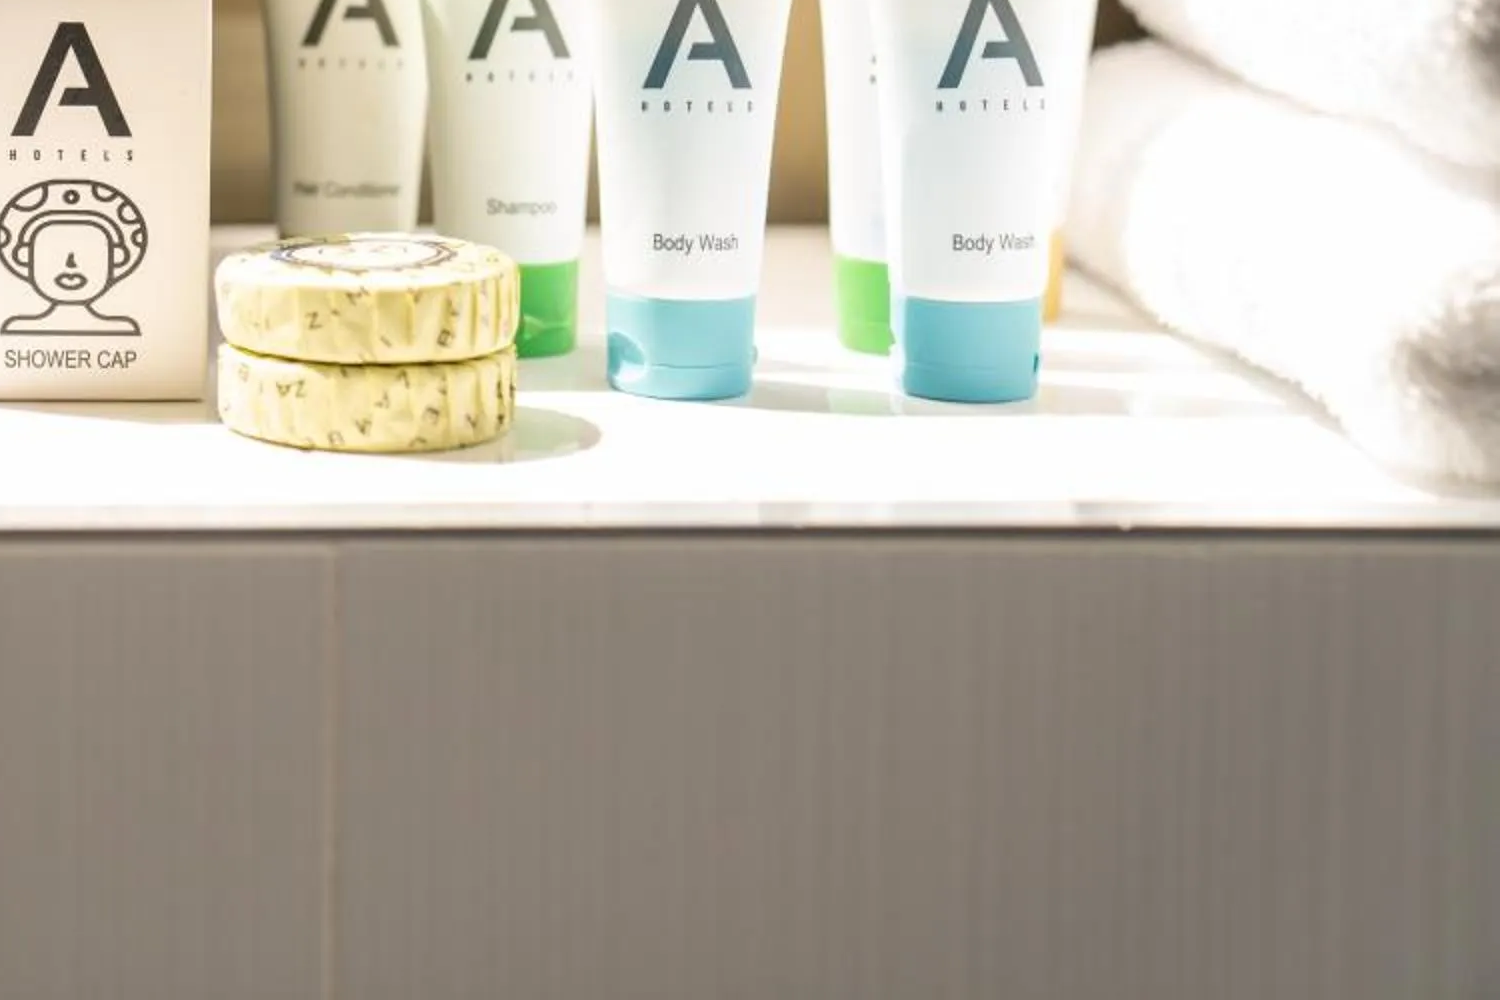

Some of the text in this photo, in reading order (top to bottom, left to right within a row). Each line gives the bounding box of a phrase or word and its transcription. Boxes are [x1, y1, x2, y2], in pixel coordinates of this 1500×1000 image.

[9, 21, 133, 137] A
[8, 149, 133, 162] HOTELS
[652, 232, 739, 256] Body Wash
[952, 232, 995, 256] Body
[4, 349, 138, 369] SHOWER CAP
